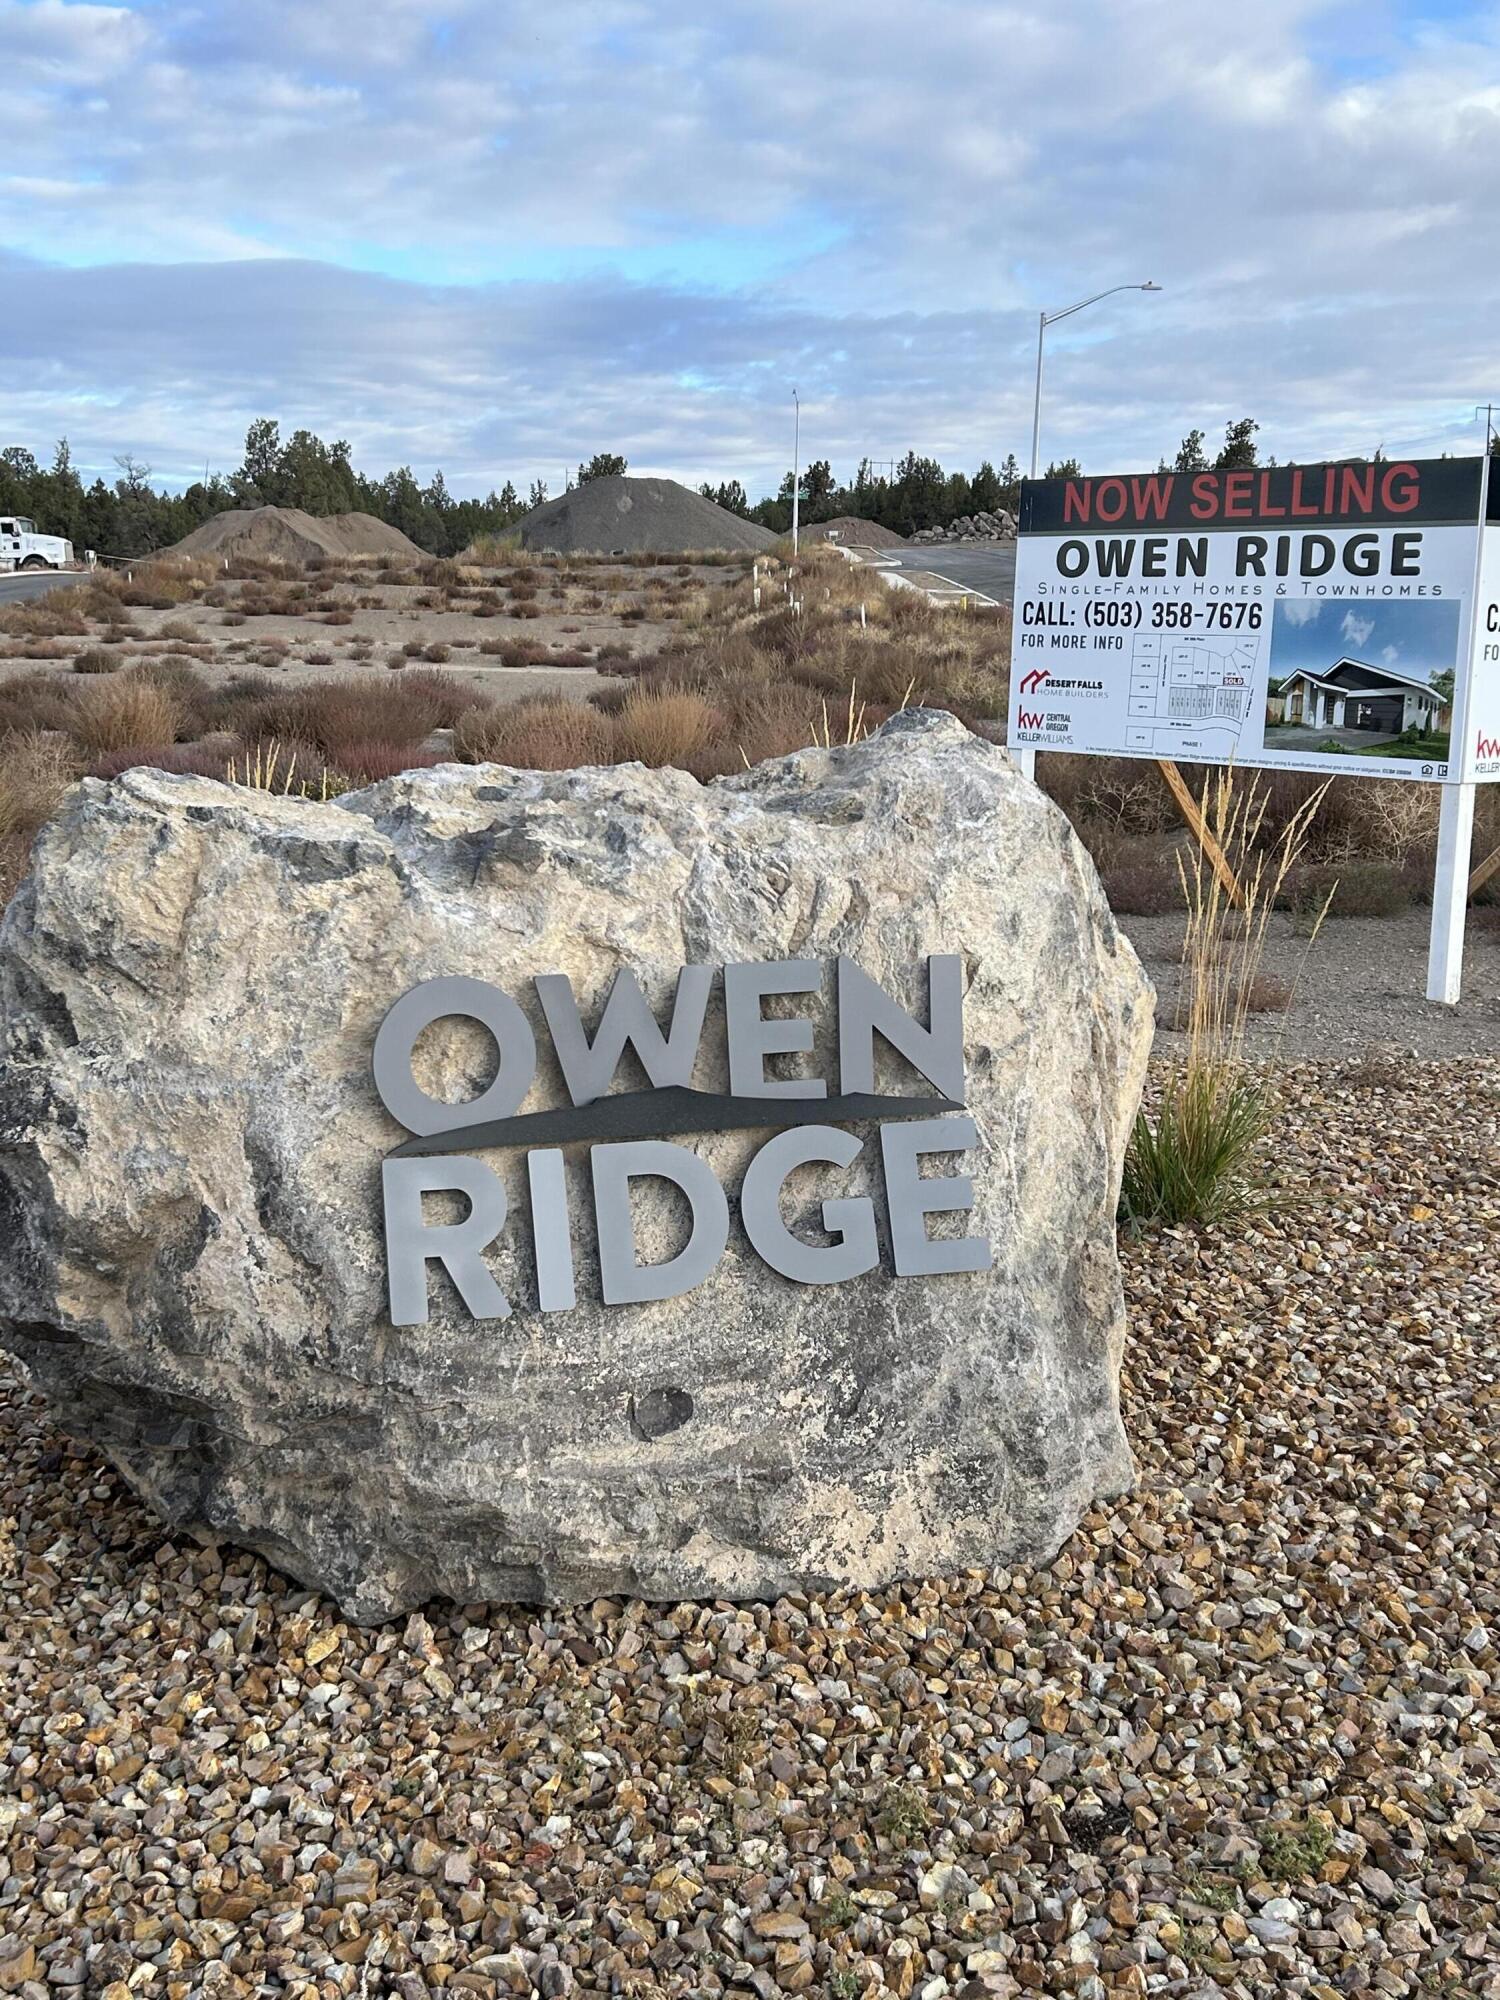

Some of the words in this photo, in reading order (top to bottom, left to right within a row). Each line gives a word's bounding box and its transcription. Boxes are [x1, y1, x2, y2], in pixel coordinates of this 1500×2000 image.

[1064, 476, 1174, 522] NOW
[1190, 464, 1419, 519] SELLING
[1056, 537, 1208, 578] OWEN
[1236, 533, 1423, 577] RIDGE
[1276, 583, 1287, 595] &
[1023, 601, 1075, 626] CALL:
[1084, 600, 1142, 629] (503)
[1151, 602, 1263, 629] 358-7676
[1487, 603, 1500, 632] C
[1021, 634, 1044, 648] FOR
[1051, 635, 1087, 649] MORE
[1094, 636, 1123, 650] INFO
[1045, 679, 1077, 688] DESERT
[1077, 680, 1103, 689] FALLS
[1046, 713, 1071, 722] CENTRAL
[1046, 723, 1069, 732] OREGON
[373, 954, 965, 1137] OWEN
[382, 1117, 992, 1326] RIDGE
